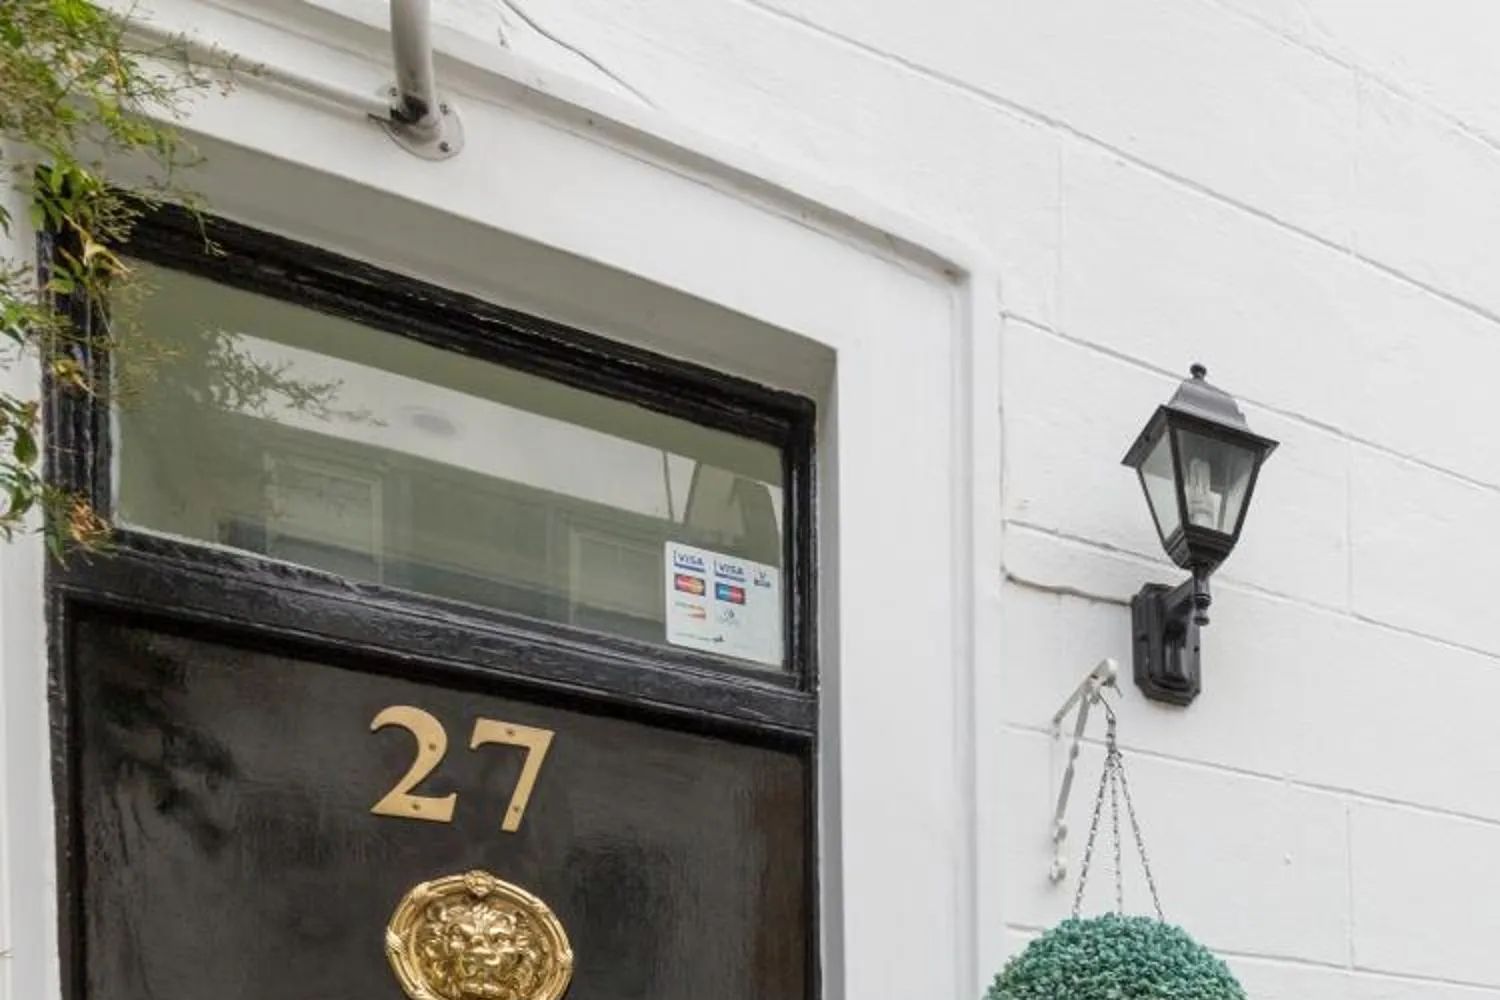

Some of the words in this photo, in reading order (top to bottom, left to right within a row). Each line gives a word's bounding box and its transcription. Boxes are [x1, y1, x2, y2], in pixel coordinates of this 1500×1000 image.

[678, 553, 704, 565] VISA
[719, 563, 744, 575] VISA
[370, 705, 556, 833] 27
